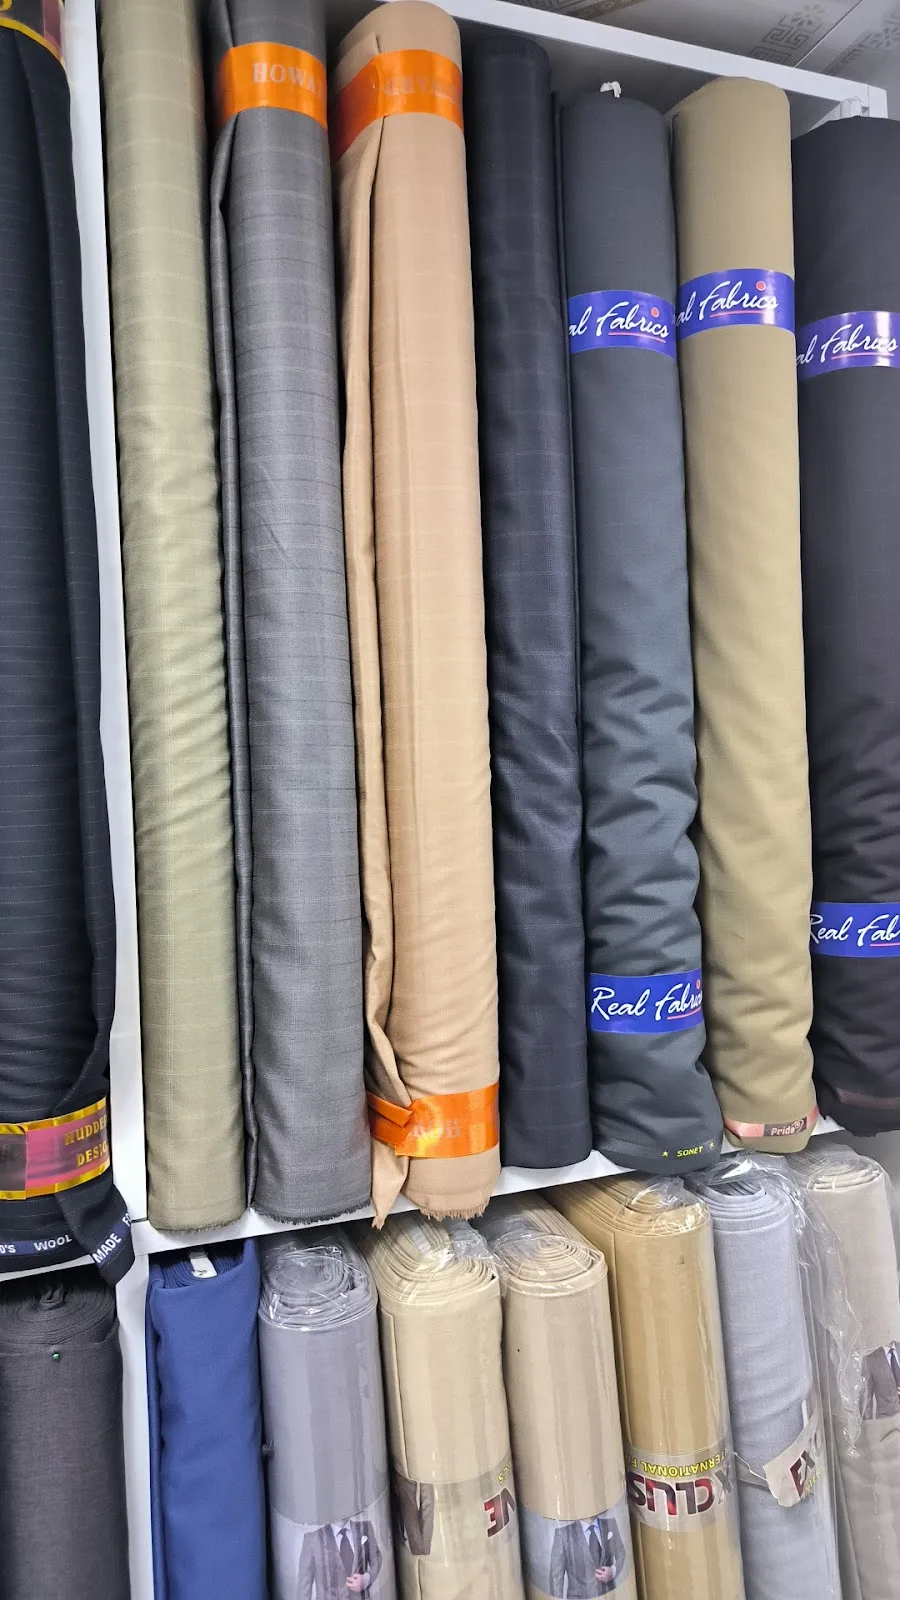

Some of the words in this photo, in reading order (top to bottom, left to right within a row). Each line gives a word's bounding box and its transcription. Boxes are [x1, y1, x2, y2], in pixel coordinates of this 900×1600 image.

[699, 281, 779, 321] Fabrics
[596, 301, 669, 338] Fabrics
[809, 914, 853, 944] Real
[591, 987, 651, 1020] Real
[770, 1123, 796, 1136] Pride
[677, 1146, 703, 1157] SONET
[33, 1235, 72, 1251] WOOL
[92, 1233, 122, 1263] MADE
